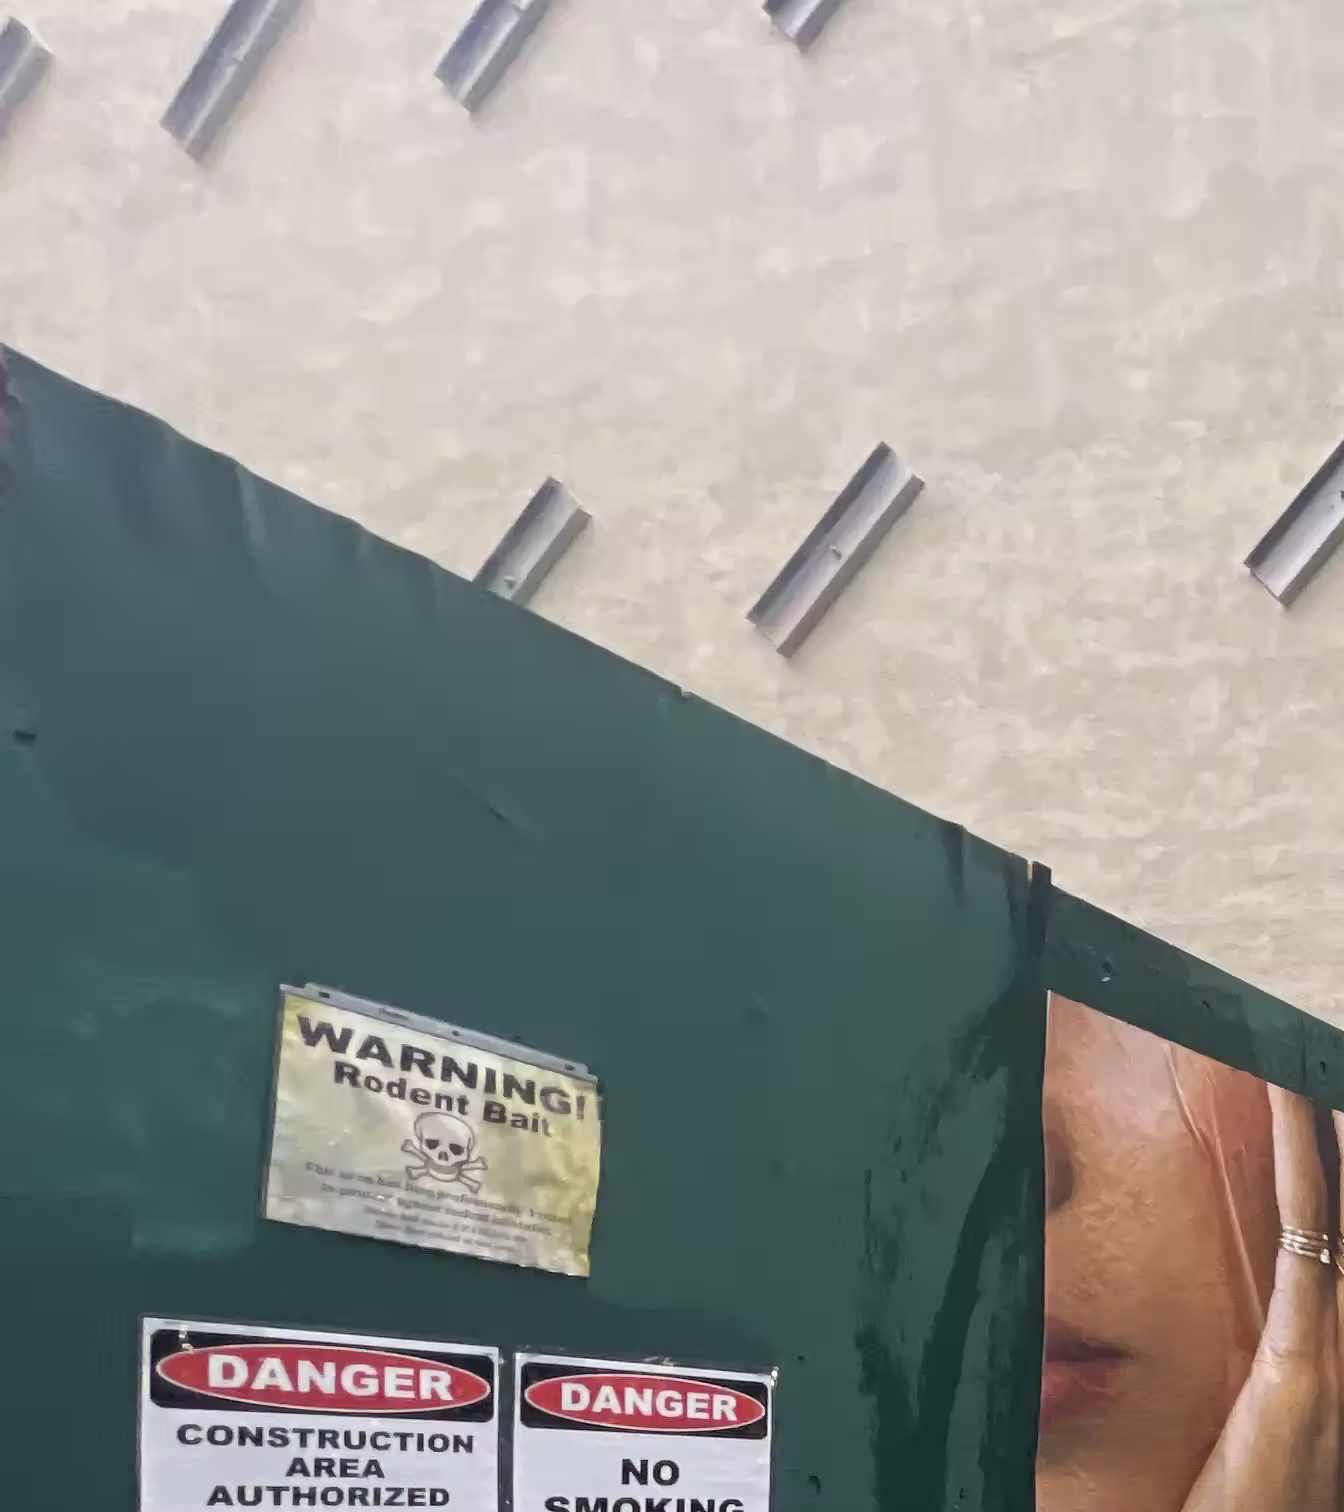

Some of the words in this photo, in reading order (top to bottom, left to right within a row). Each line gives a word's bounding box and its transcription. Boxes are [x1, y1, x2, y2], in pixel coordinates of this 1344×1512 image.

[296, 1014, 586, 1121] WARNING!
[333, 1060, 470, 1116] Rodent
[482, 1100, 555, 1138] Bait
[207, 1353, 454, 1401] DANGER
[561, 1382, 738, 1422] DANGER
[176, 1423, 474, 1454] CONSTRUCTION
[285, 1456, 386, 1479] AREA
[621, 1458, 680, 1486] NO
[206, 1485, 451, 1507] AUTHORIZED
